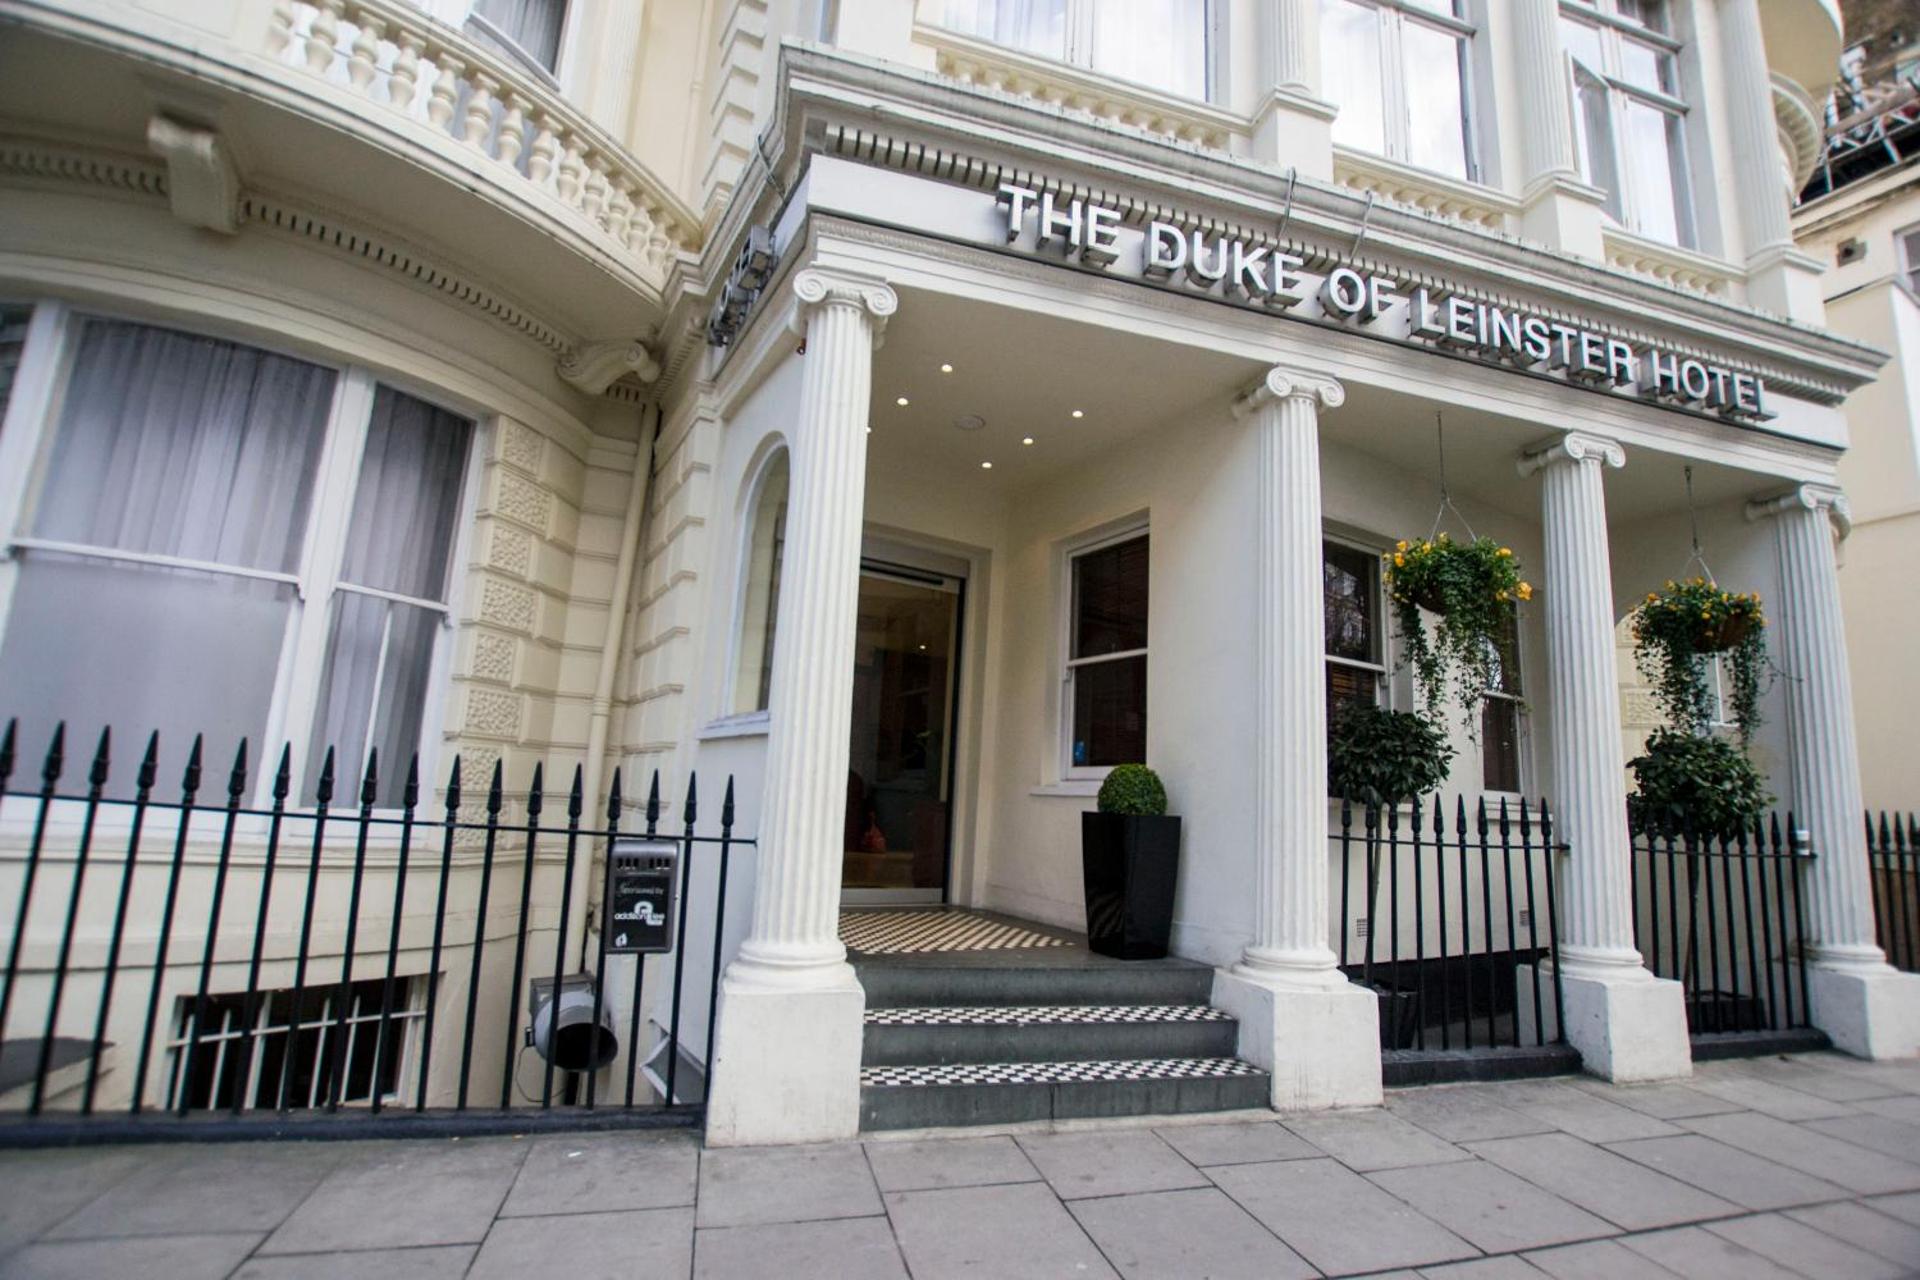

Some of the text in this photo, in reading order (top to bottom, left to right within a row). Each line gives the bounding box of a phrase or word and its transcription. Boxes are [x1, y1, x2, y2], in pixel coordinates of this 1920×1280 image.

[998, 183, 1777, 418] THE DUKE OF LEINSTER HOTEL
